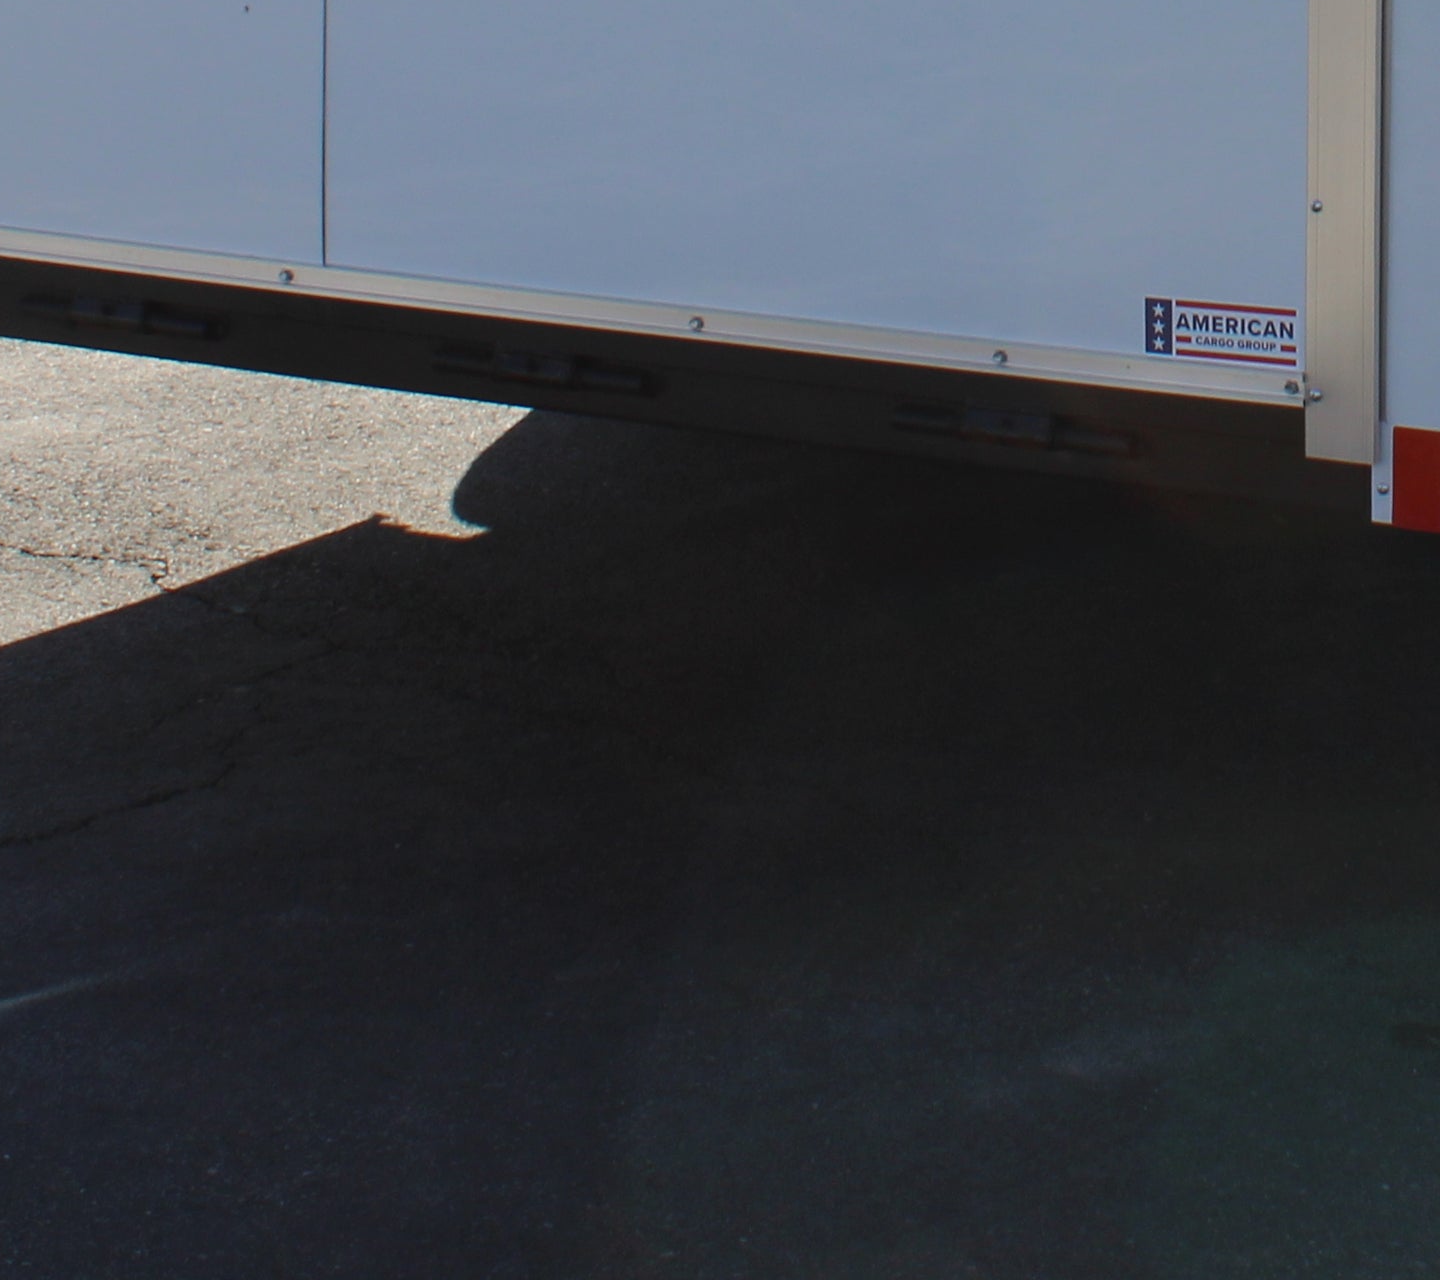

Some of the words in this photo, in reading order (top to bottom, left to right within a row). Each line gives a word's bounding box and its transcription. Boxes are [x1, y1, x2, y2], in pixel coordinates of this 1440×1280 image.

[1176, 312, 1294, 340] AMERICAN
[1195, 336, 1234, 348] CARGO
[1237, 340, 1276, 352] GROUP
